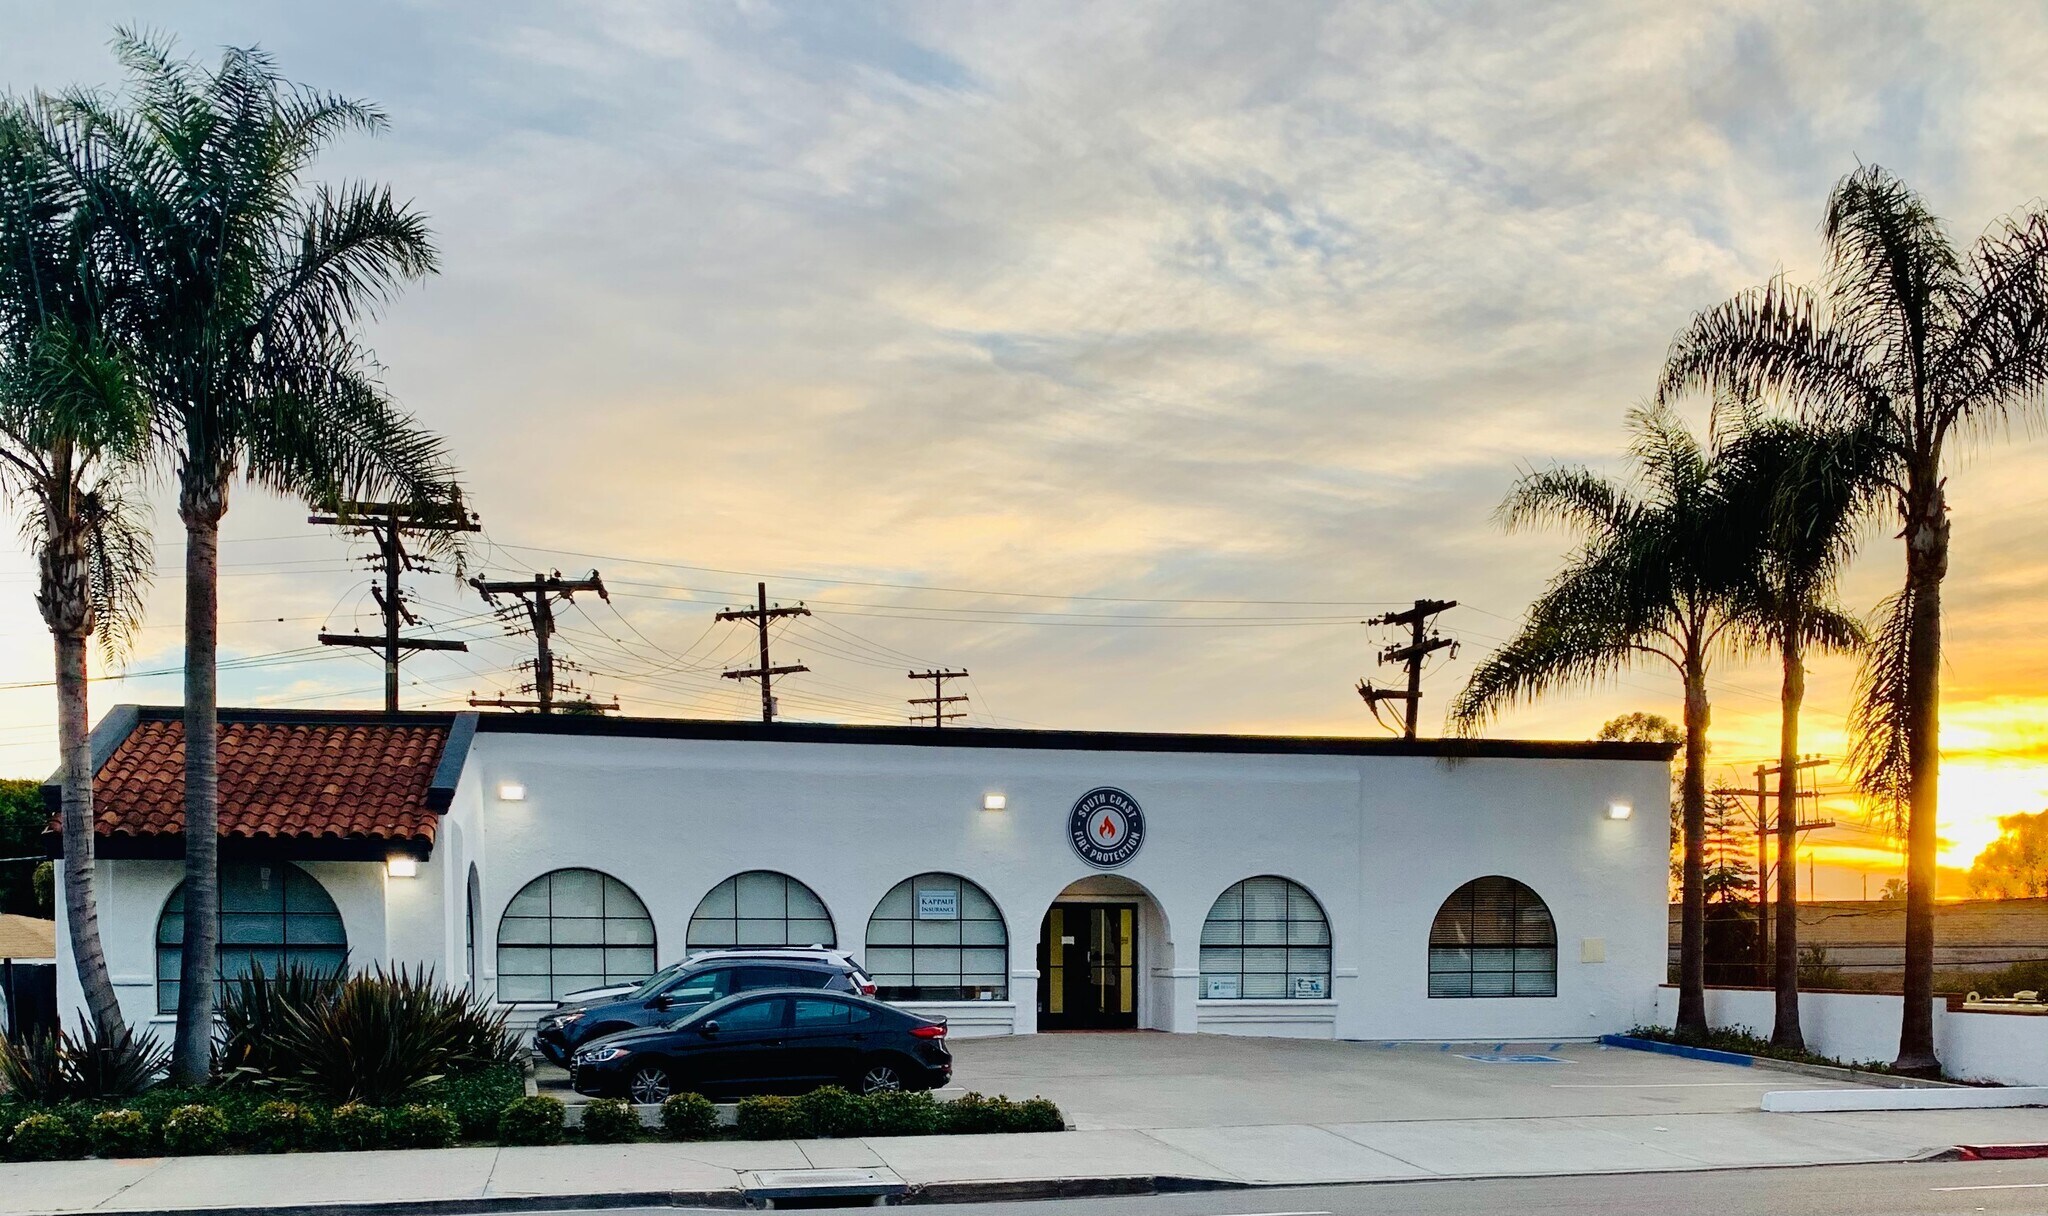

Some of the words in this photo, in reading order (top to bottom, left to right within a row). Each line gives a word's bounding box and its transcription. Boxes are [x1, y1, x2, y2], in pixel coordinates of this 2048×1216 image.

[1078, 793, 1106, 818] SOUTH
[1109, 794, 1137, 818] COAST
[1074, 830, 1091, 853] FIRE
[1089, 831, 1141, 862] PROTECTION
